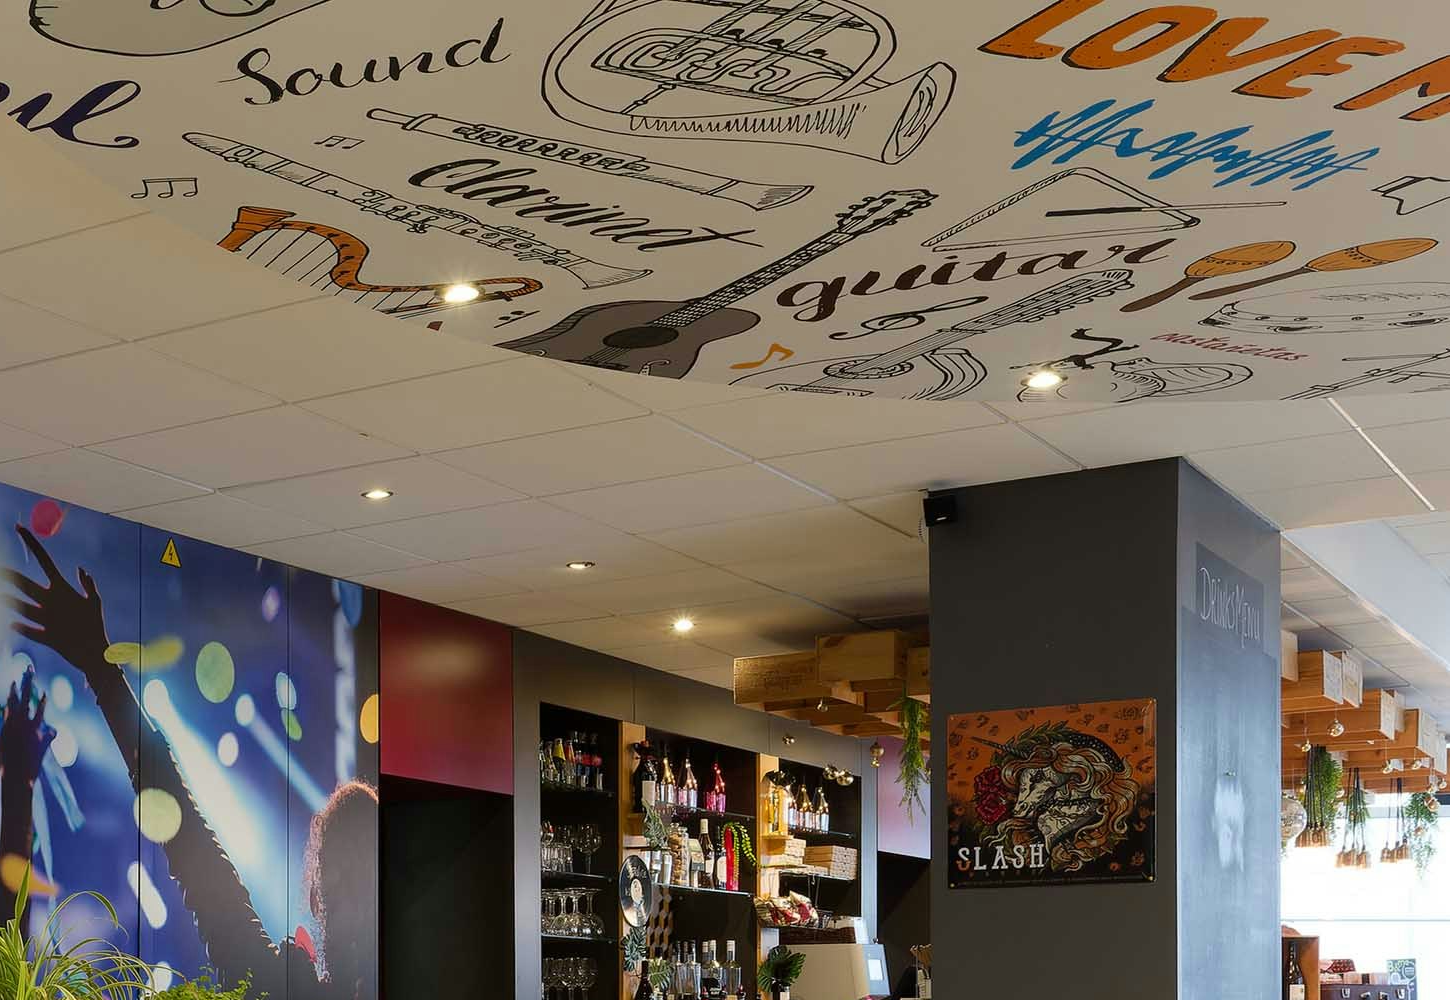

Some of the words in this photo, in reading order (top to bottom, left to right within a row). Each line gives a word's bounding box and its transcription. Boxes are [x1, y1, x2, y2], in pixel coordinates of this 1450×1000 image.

[218, 17, 511, 105] Sound
[977, 0, 1405, 99] LOVE
[776, 238, 1178, 322] guitar
[955, 843, 1046, 871] SLASH
